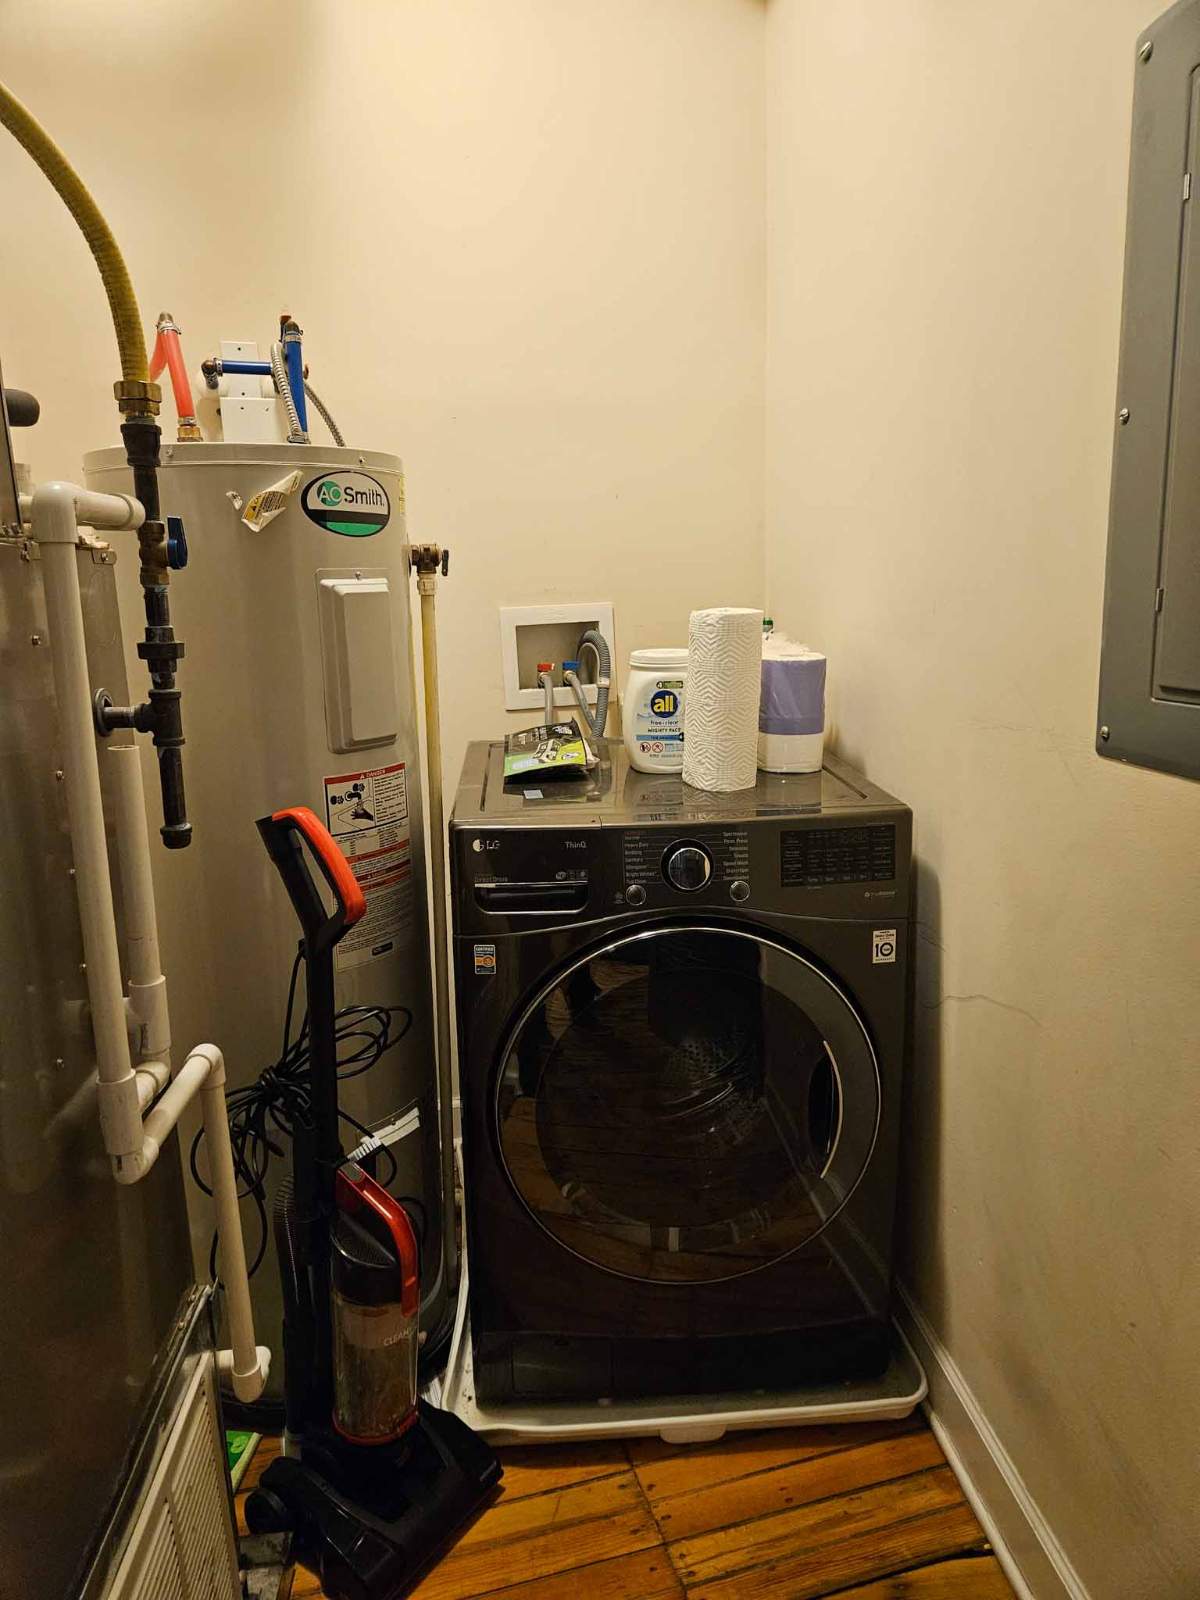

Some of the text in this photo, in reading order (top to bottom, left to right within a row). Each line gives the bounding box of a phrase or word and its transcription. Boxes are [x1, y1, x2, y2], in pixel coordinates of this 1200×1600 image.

[653, 695, 674, 713] all
[486, 840, 587, 850] LG ThinQ
[875, 942, 894, 958] 10
